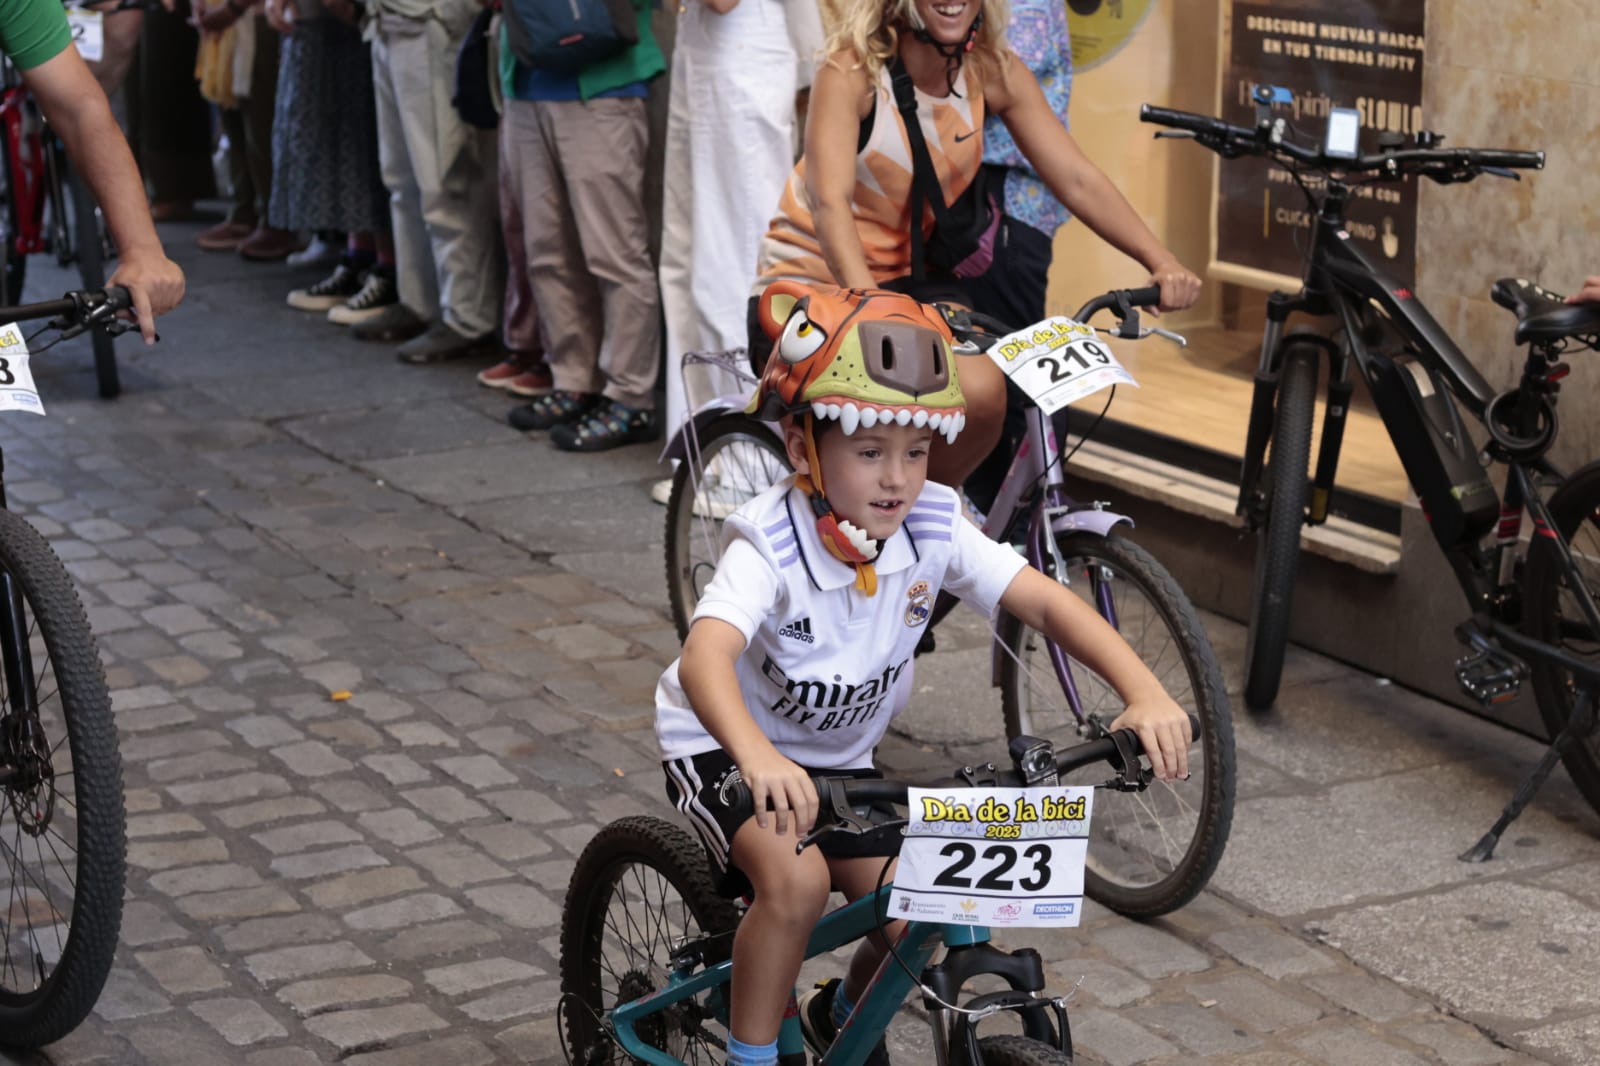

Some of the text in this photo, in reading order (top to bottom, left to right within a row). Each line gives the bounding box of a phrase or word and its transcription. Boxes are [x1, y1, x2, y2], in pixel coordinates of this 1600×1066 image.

[1247, 15, 1316, 37] DESCUBRE
[1319, 24, 1375, 44] NUEVAS
[1263, 38, 1416, 72] EN TUS TIENDAS FIFTY
[1031, 329, 1056, 346] de
[1037, 341, 1110, 384] 219
[778, 626, 815, 645] adidas
[771, 696, 816, 724] FLY
[921, 795, 1086, 822] Día de la bici
[984, 824, 1021, 839] 2023
[932, 842, 1053, 892] 223
